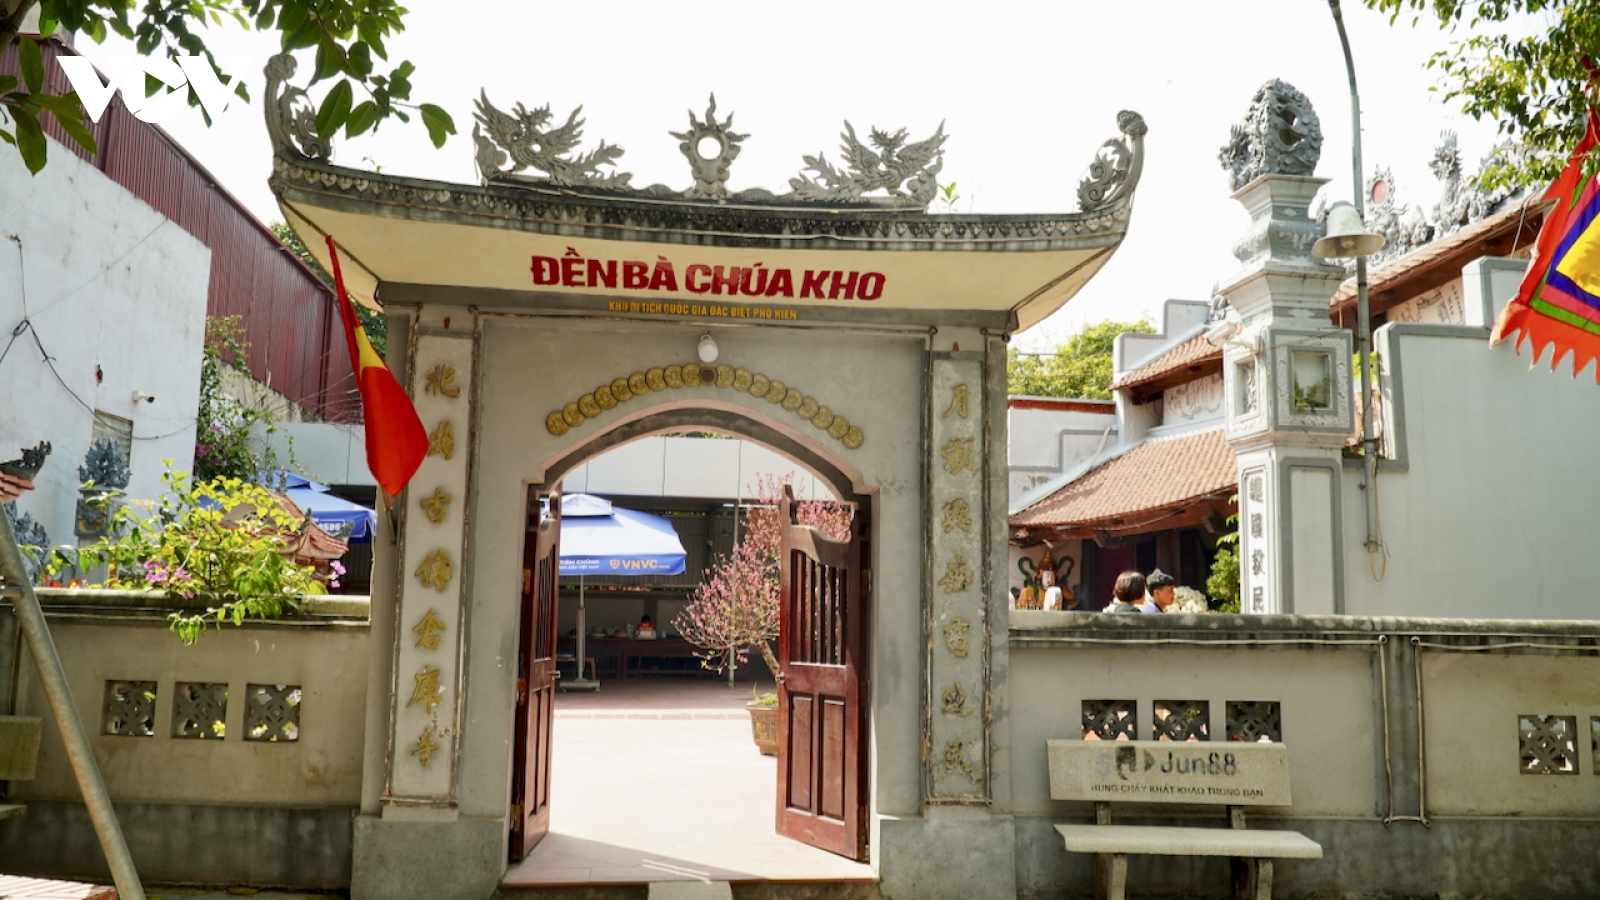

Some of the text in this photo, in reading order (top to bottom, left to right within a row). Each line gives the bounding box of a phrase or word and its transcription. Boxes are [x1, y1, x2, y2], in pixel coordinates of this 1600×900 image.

[530, 246, 886, 301] ĐỀN BÀ CHÚA KHO
[609, 301, 629, 311] KHU
[691, 305, 707, 316] GIA
[622, 559, 659, 570] VNVC
[1160, 751, 1237, 776] Jun88
